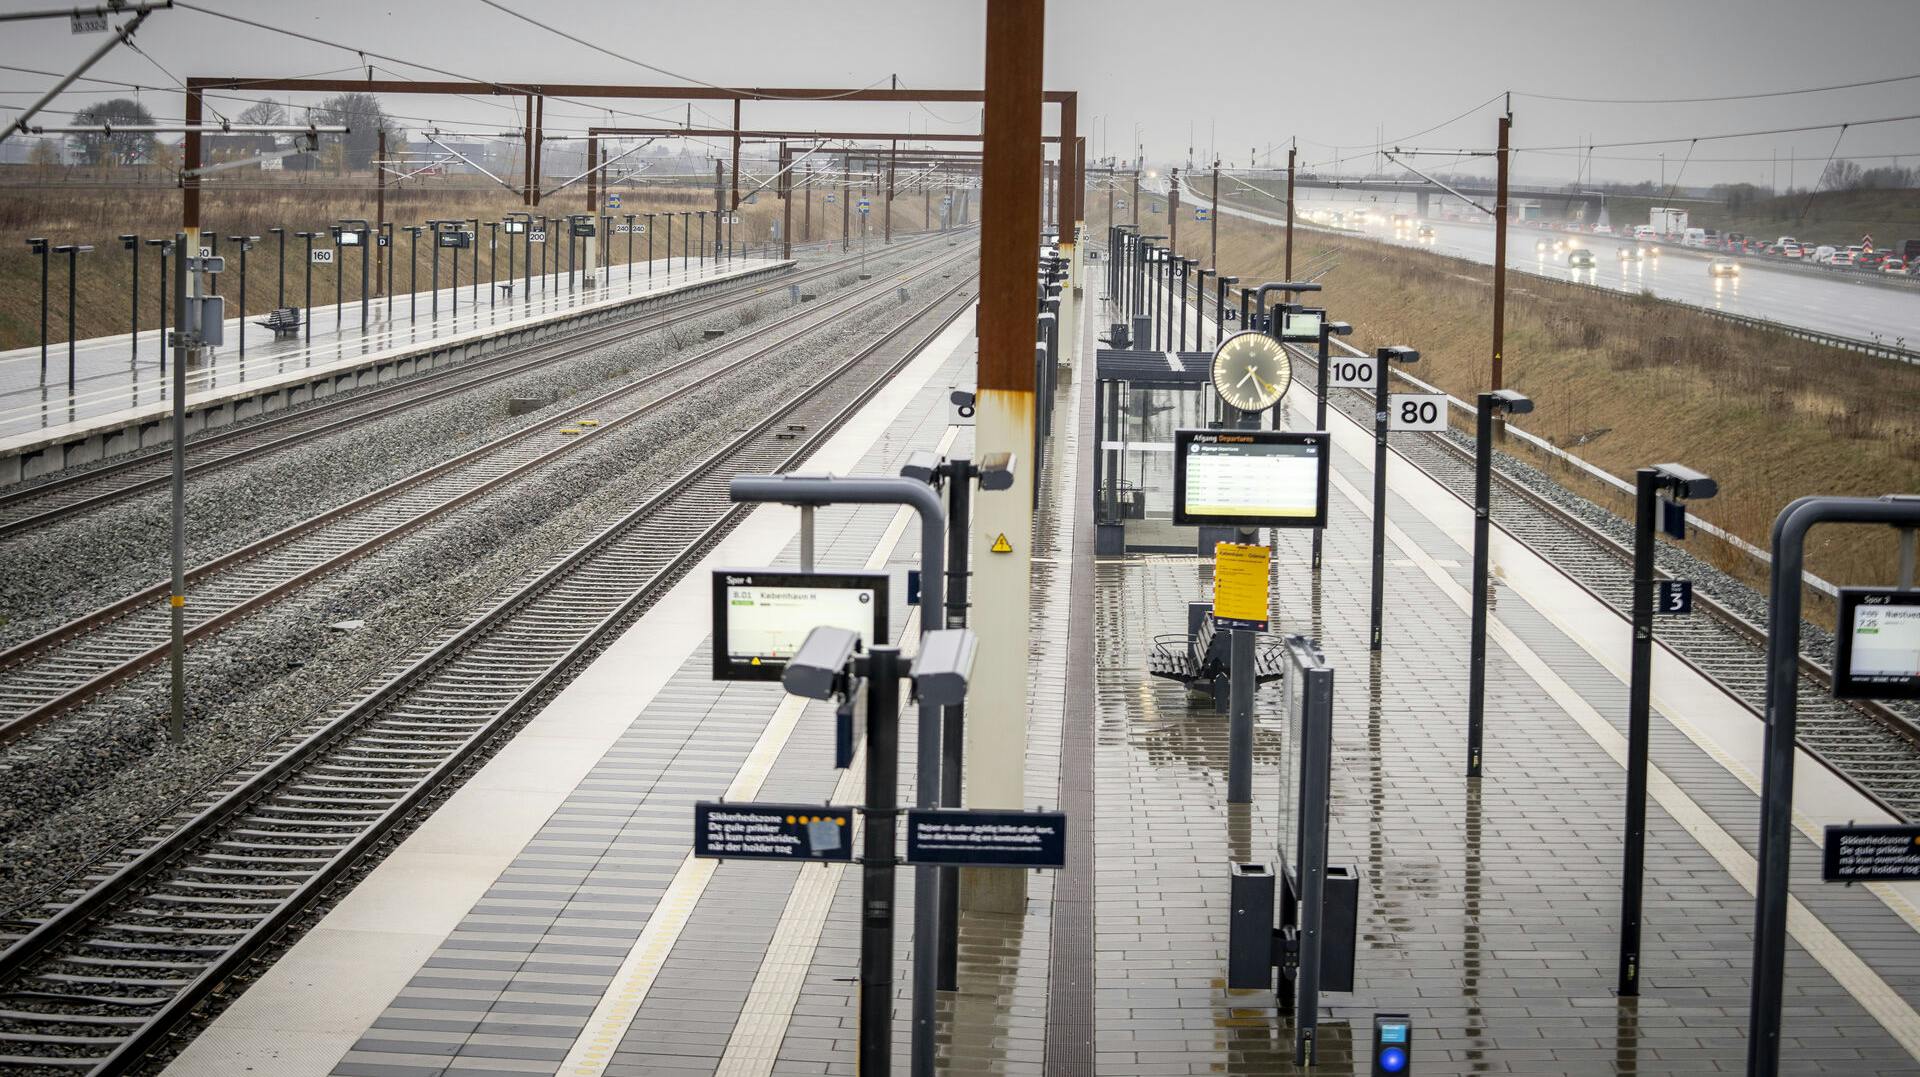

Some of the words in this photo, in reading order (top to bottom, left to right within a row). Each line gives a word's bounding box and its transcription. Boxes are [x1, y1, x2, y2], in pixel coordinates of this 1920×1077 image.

[313, 251, 331, 261] 160
[1333, 362, 1373, 382] 100
[1401, 401, 1438, 423] 80
[1193, 434, 1218, 443] Afgang
[1218, 434, 1254, 443] Departures
[726, 575, 745, 586] Spor
[1669, 592, 1683, 611] 3
[1864, 594, 1883, 605] Spor
[708, 811, 783, 823] Sikkerhedszone
[708, 822, 723, 831] De
[723, 823, 746, 833] gule
[725, 832, 744, 841] kun
